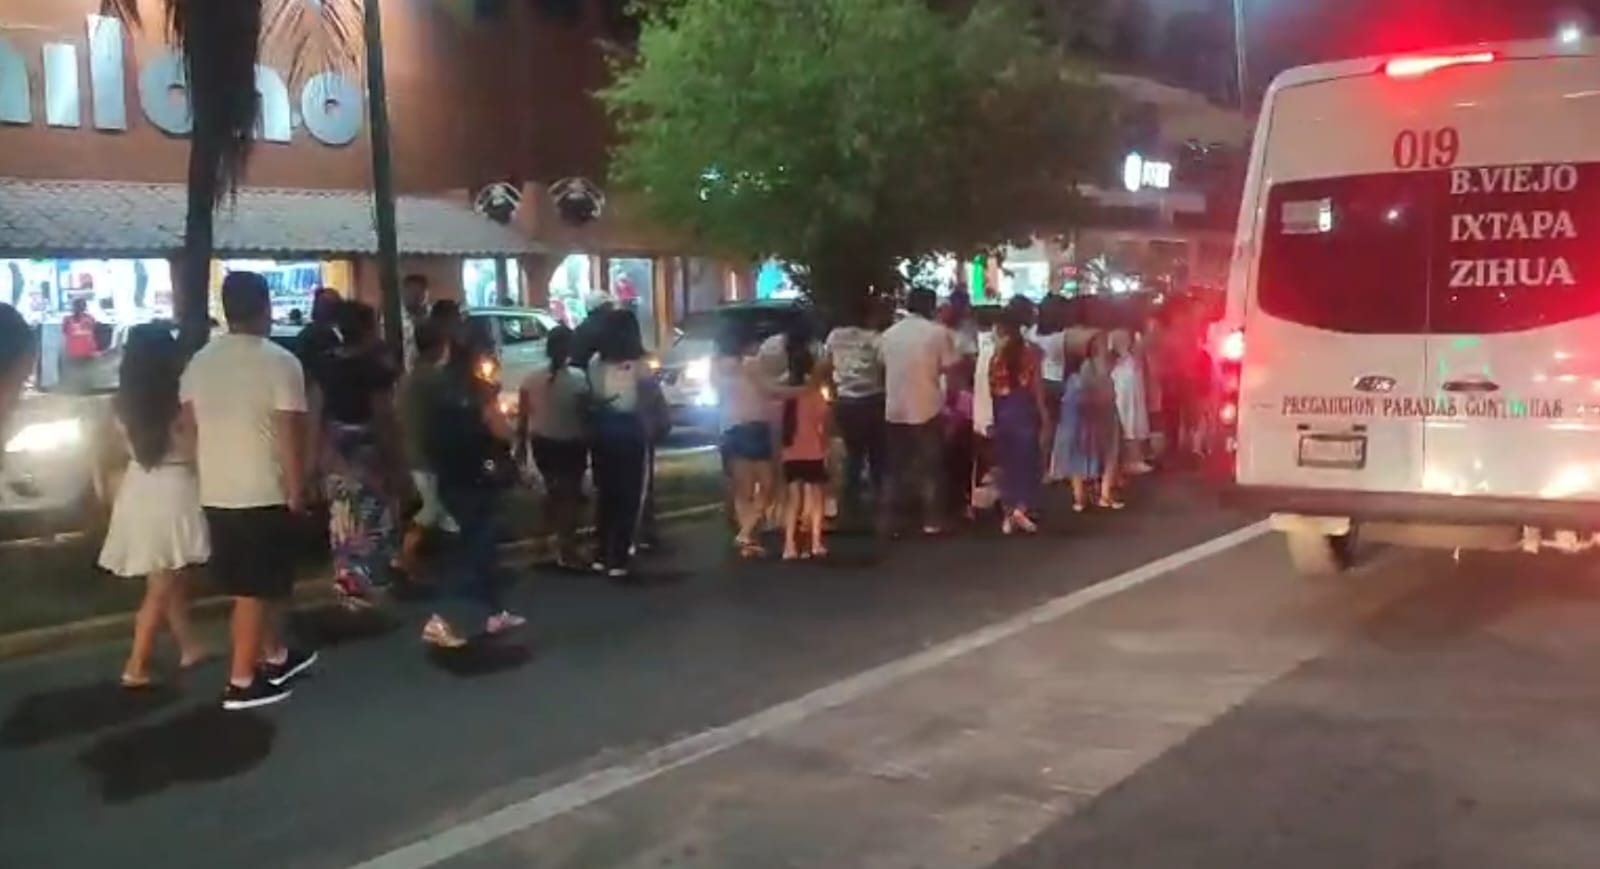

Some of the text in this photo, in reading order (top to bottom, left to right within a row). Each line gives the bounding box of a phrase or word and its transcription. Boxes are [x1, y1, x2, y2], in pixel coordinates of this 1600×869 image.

[1393, 127, 1459, 169] 019
[1451, 165, 1578, 194] B.VIEJO
[1451, 211, 1577, 242] IXTAPA
[1450, 258, 1575, 288] ZIHUA
[1383, 397, 1457, 417] PARADAS
